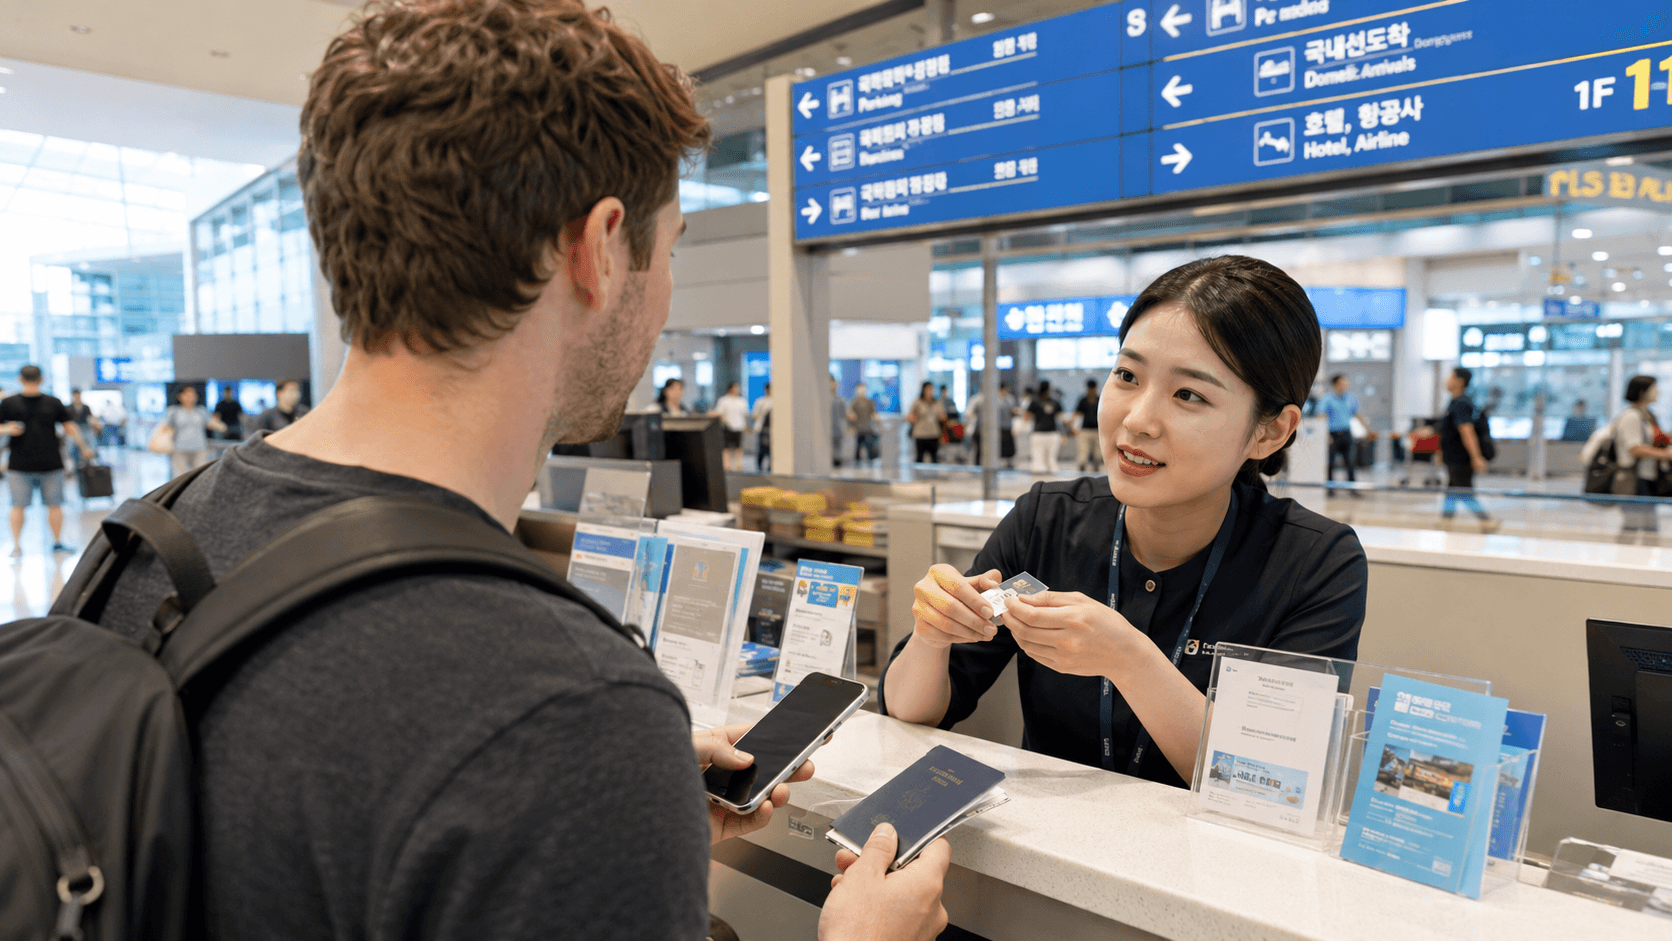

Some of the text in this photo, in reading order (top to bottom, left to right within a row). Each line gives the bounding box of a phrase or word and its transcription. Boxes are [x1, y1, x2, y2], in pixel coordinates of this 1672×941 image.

[1126, 7, 1147, 38] S
[1303, 20, 1411, 64] 국내선도착
[1359, 54, 1417, 79] Arrivals
[1574, 76, 1617, 111] 1F
[1303, 94, 1425, 137] 호텔, 항공사
[1303, 131, 1410, 160] Hotel, Airline
